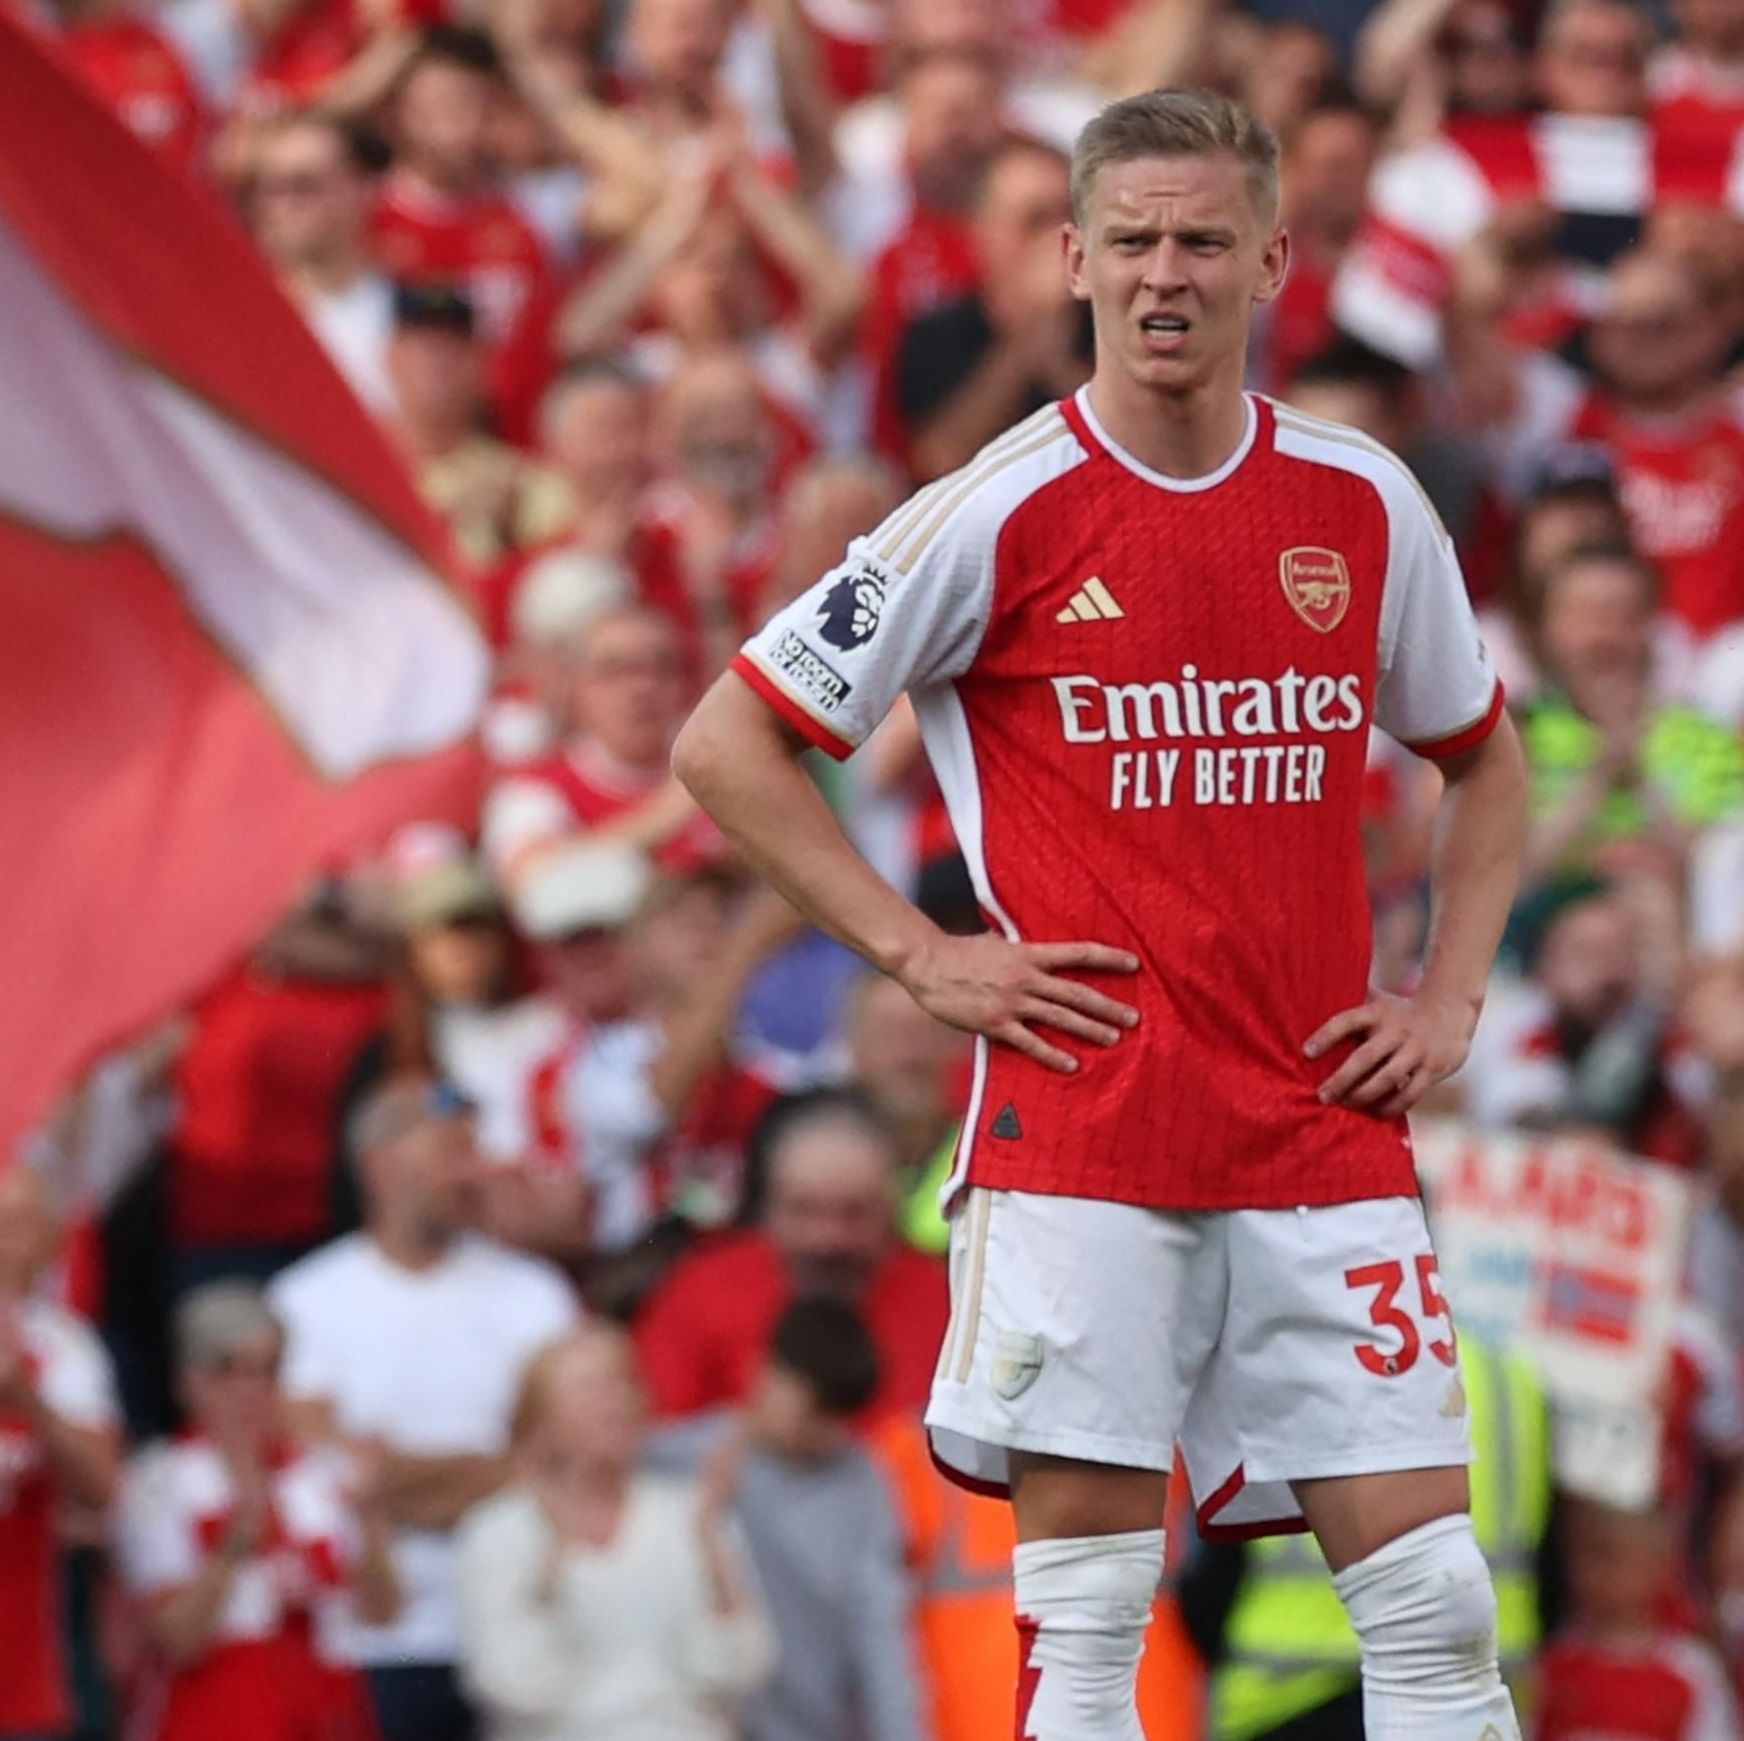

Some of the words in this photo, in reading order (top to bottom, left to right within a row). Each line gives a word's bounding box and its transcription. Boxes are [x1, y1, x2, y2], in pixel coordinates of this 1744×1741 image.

[1050, 663, 1364, 743] Emirates
[1111, 750, 1180, 810] FLY
[1195, 745, 1325, 805] BETTER
[1344, 1253, 1457, 1378] 35
